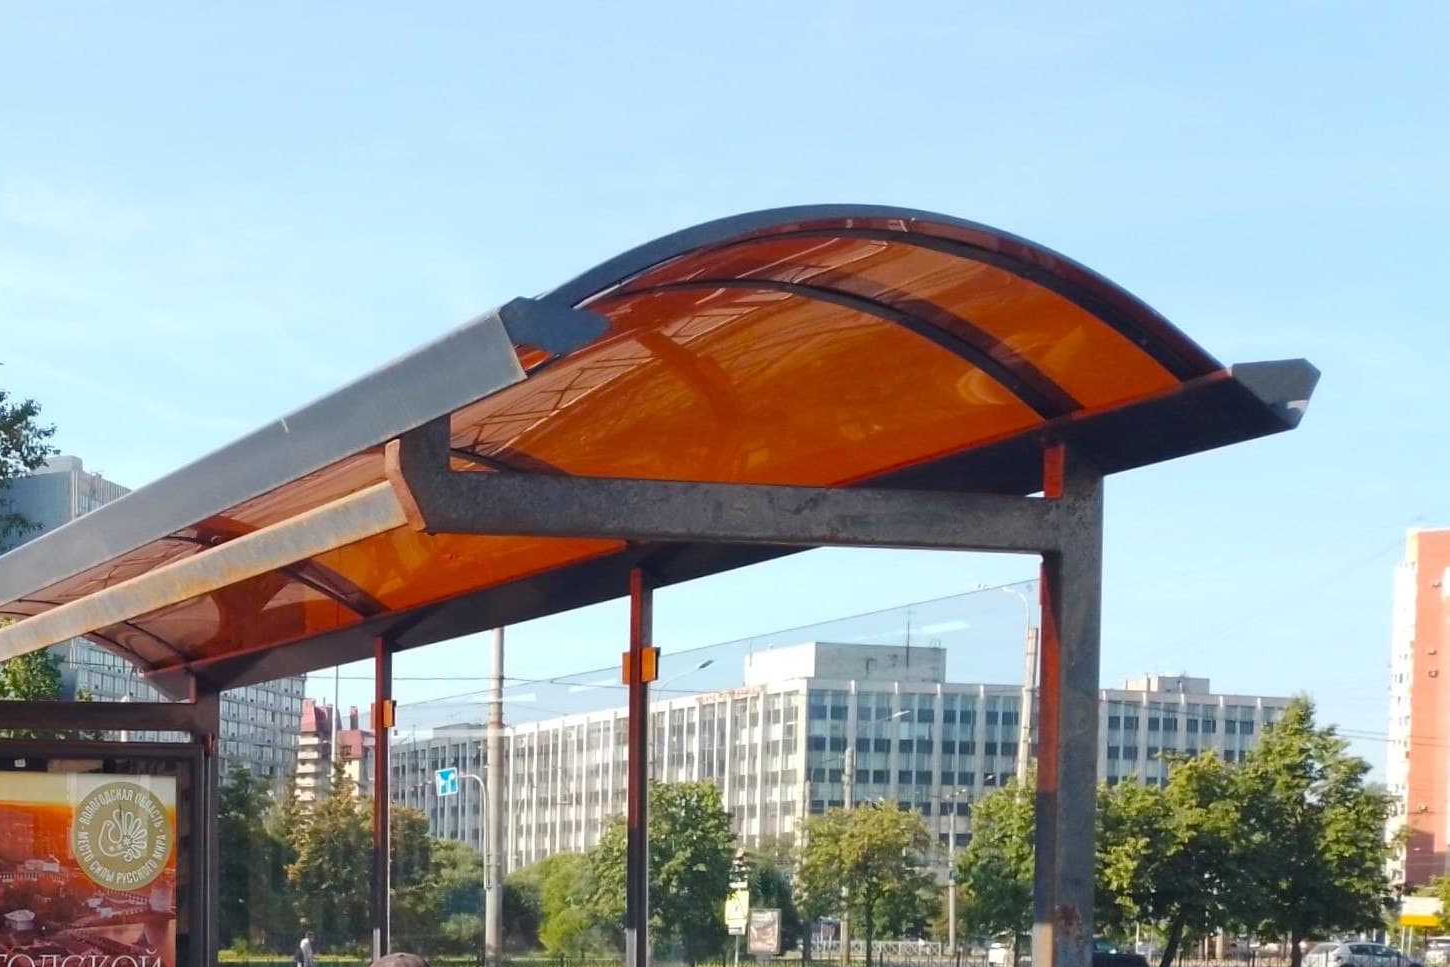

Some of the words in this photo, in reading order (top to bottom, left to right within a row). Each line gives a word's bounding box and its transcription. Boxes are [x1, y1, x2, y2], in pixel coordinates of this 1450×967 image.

[79, 788, 134, 825] ВОЛОГОДСКАЯ
[134, 793, 165, 828] ОБЛАСТЬ
[78, 831, 95, 863] МЕСТО
[90, 860, 115, 881] СИЛЫ
[116, 859, 158, 884] РУССКОГО
[153, 834, 167, 860] МИРА
